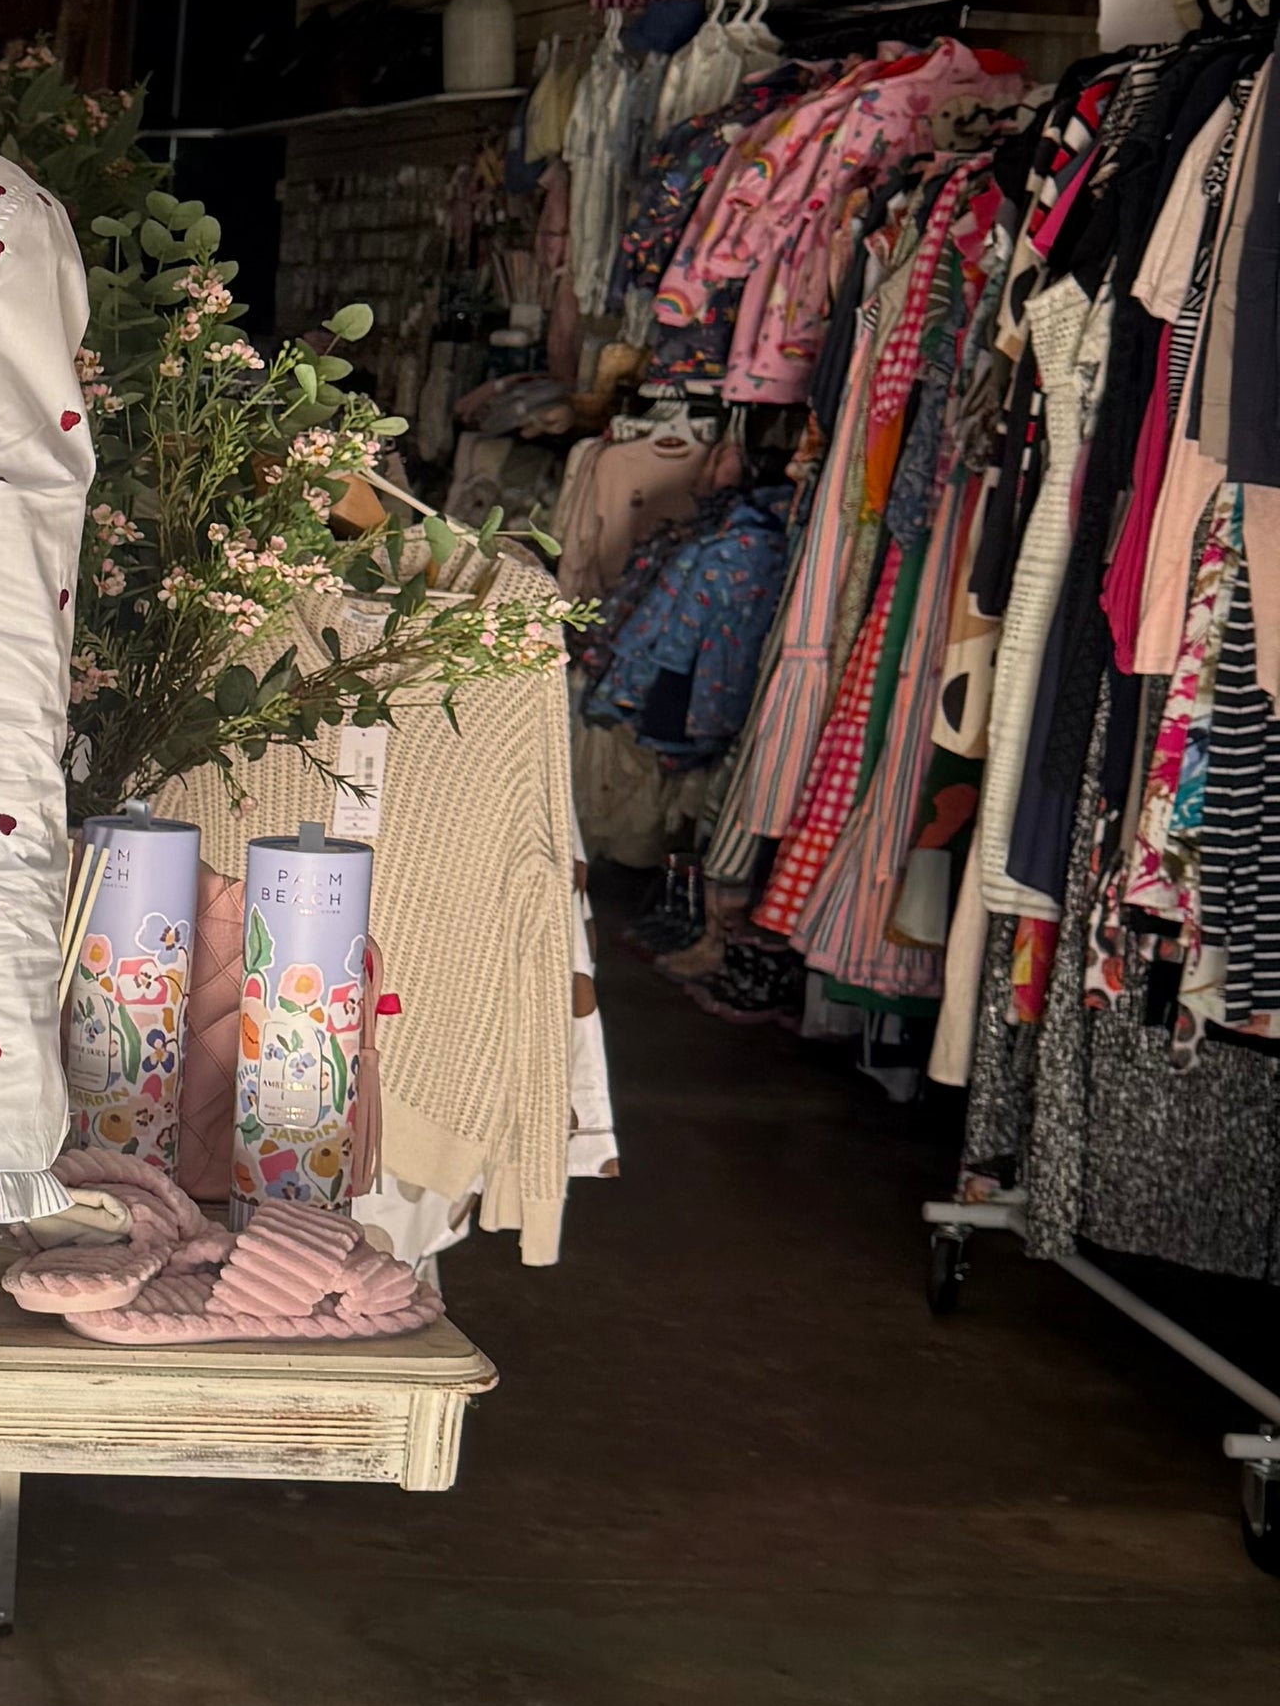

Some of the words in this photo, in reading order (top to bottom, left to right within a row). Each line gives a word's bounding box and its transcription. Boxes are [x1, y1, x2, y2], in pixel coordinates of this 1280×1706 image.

[277, 869, 343, 886] PALM
[261, 887, 341, 906] BEACH
[269, 1119, 339, 1144] JARDIN
